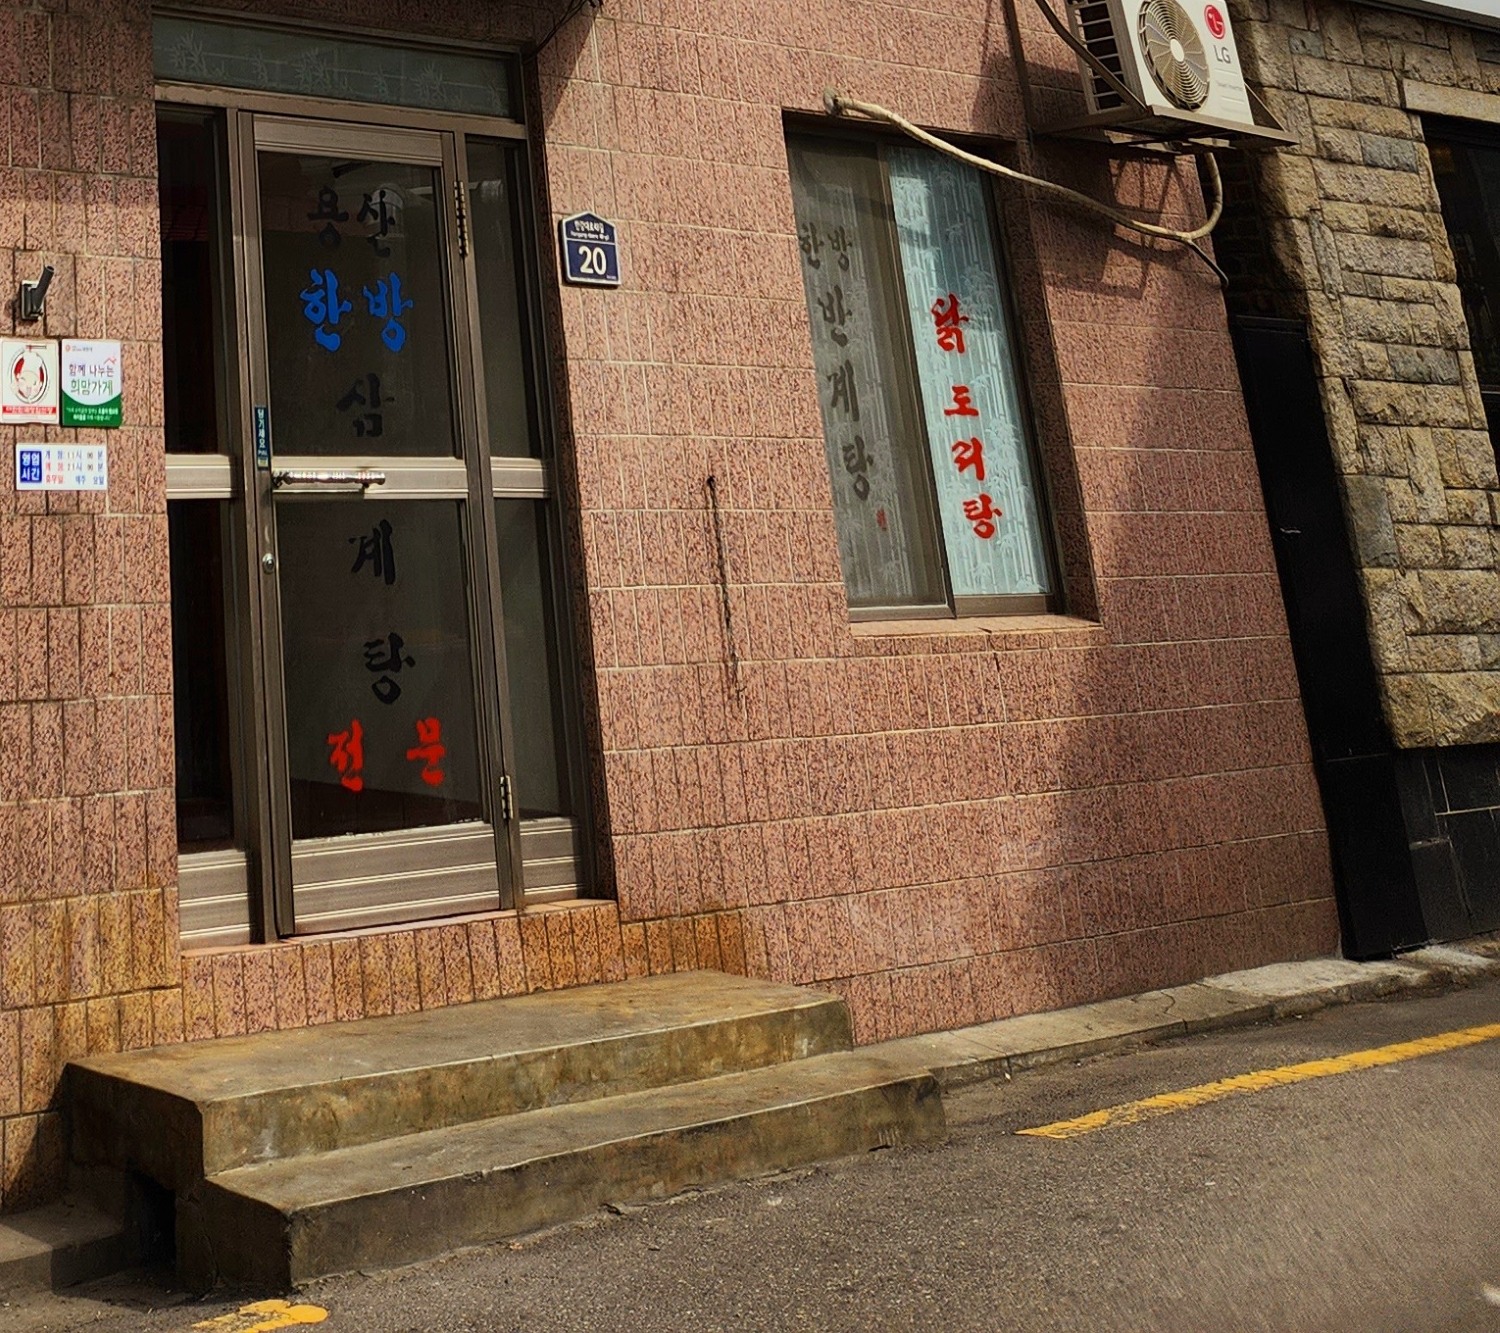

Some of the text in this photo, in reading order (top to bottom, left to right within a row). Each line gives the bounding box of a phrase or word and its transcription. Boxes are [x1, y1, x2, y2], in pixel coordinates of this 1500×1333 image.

[1213, 44, 1232, 64] LG
[307, 185, 395, 258] 용산
[798, 221, 853, 271] 한방
[578, 245, 607, 275] 20
[300, 269, 414, 353] 한방
[70, 379, 113, 396] 희망가게
[818, 284, 874, 501] 반계탕
[931, 293, 1003, 539] 닭도리탕
[21, 452, 40, 466] 영업
[21, 466, 40, 481] 시간
[326, 718, 446, 792] 전문
